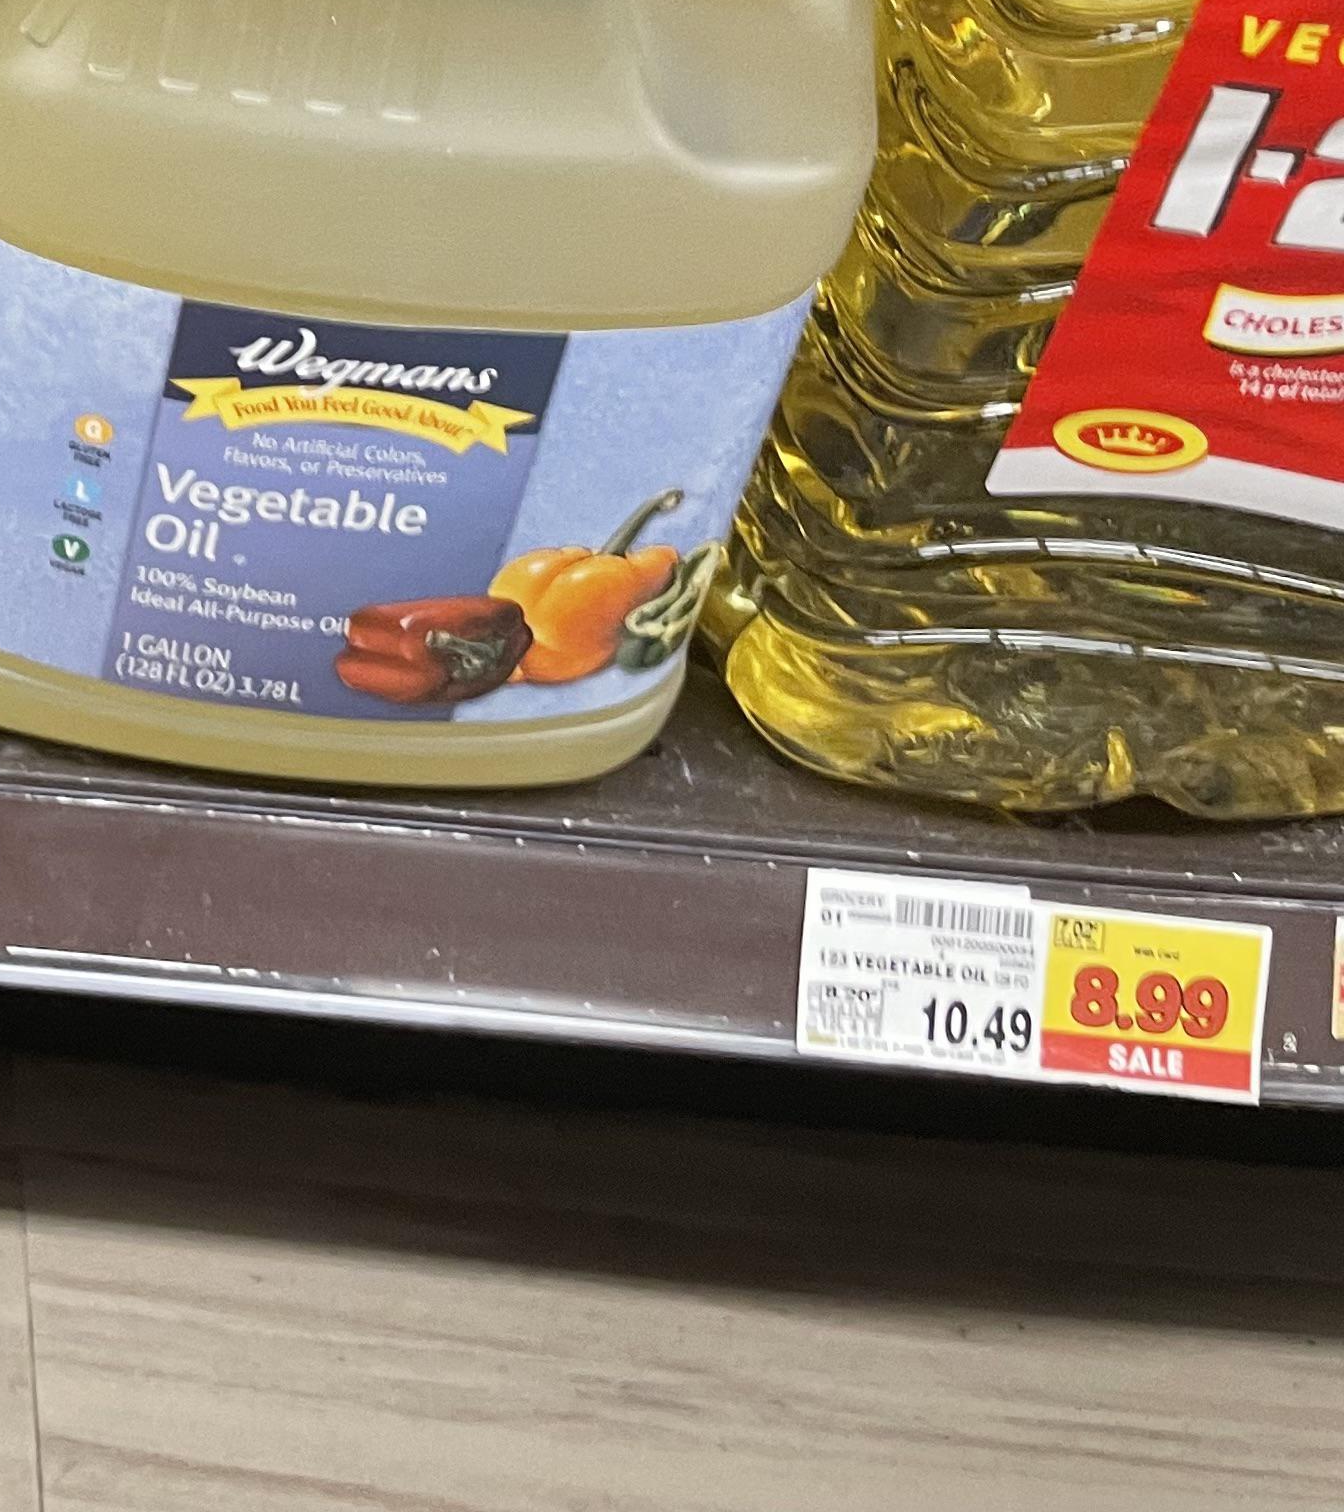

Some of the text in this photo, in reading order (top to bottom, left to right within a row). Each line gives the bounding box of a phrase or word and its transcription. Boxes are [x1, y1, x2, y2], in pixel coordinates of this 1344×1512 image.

[1241, 14, 1344, 65] VE
[1223, 308, 1344, 338] CHOLES
[228, 327, 498, 399] Wegmans
[233, 396, 279, 419] Food
[284, 395, 317, 413] You
[323, 396, 358, 413] Feel
[362, 399, 412, 420] Good
[253, 432, 277, 450] No
[283, 436, 357, 461] Artificial
[301, 459, 320, 476] or
[326, 459, 448, 485] Preservatives
[155, 463, 428, 535] Vegetable
[145, 512, 219, 562] Oil
[137, 565, 297, 608] 100% Soybean
[131, 585, 351, 638] Ideal All-Purpose Oil
[137, 633, 231, 670] GALLON
[854, 951, 954, 982] VEGETABLE
[961, 965, 990, 987] OIL
[1070, 963, 1229, 1040] 8.99
[923, 996, 1032, 1053] 10.49
[1108, 1043, 1184, 1080] SALE
